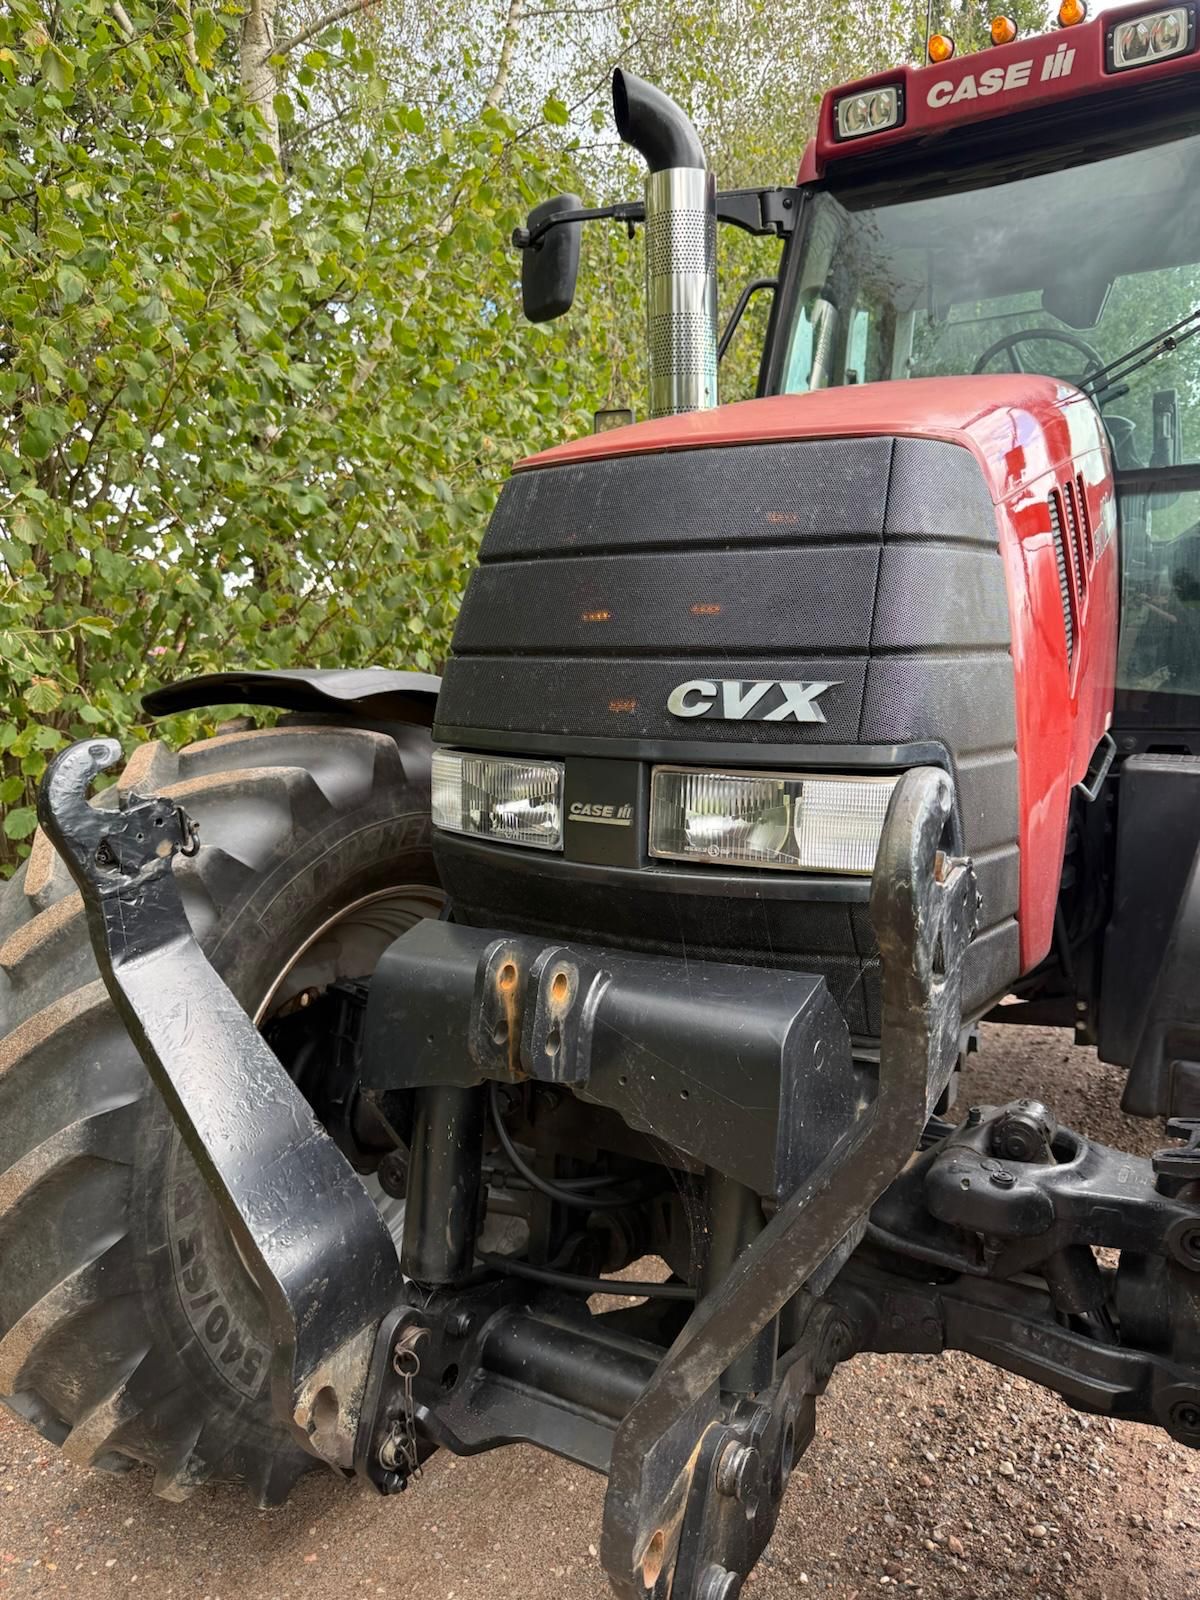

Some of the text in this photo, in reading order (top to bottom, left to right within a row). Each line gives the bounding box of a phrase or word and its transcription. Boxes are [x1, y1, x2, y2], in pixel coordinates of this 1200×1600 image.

[926, 59, 1034, 109] CASE
[667, 678, 843, 722] CVX
[570, 802, 614, 817] CASE
